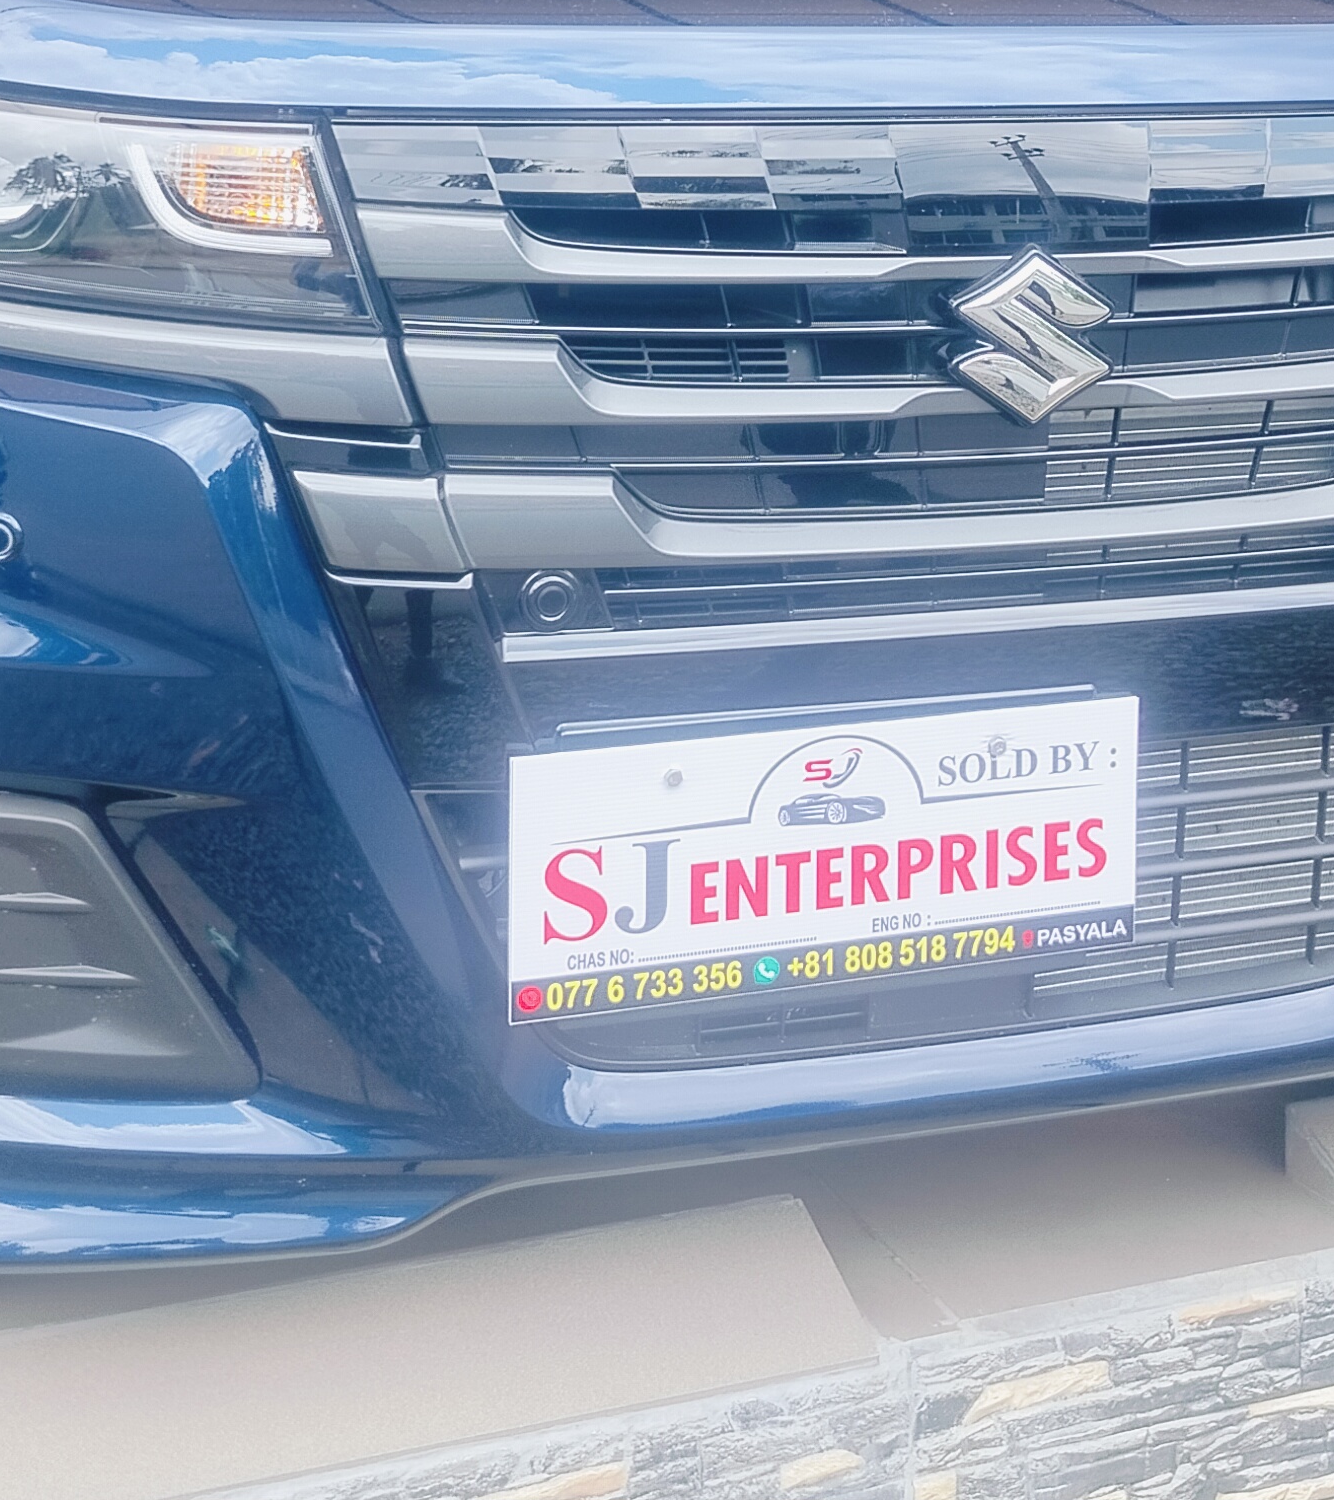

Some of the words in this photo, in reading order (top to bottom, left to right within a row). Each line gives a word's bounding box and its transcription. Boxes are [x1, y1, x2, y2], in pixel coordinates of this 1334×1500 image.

[937, 747, 1039, 787] SOLD
[1048, 740, 1100, 775] BY
[689, 817, 1108, 926] ENTERPRISES
[871, 915, 900, 933] ENG
[1036, 918, 1127, 947] PASYALA
[567, 951, 606, 971] CHAS
[609, 948, 635, 967] NO:
[787, 948, 835, 979] +81
[844, 940, 893, 973] 808
[899, 934, 946, 967] 518
[953, 925, 1016, 959] 7794
[546, 978, 599, 1011] 077
[607, 975, 624, 1003] 6
[633, 968, 683, 1000] 733
[692, 960, 743, 993] 356
